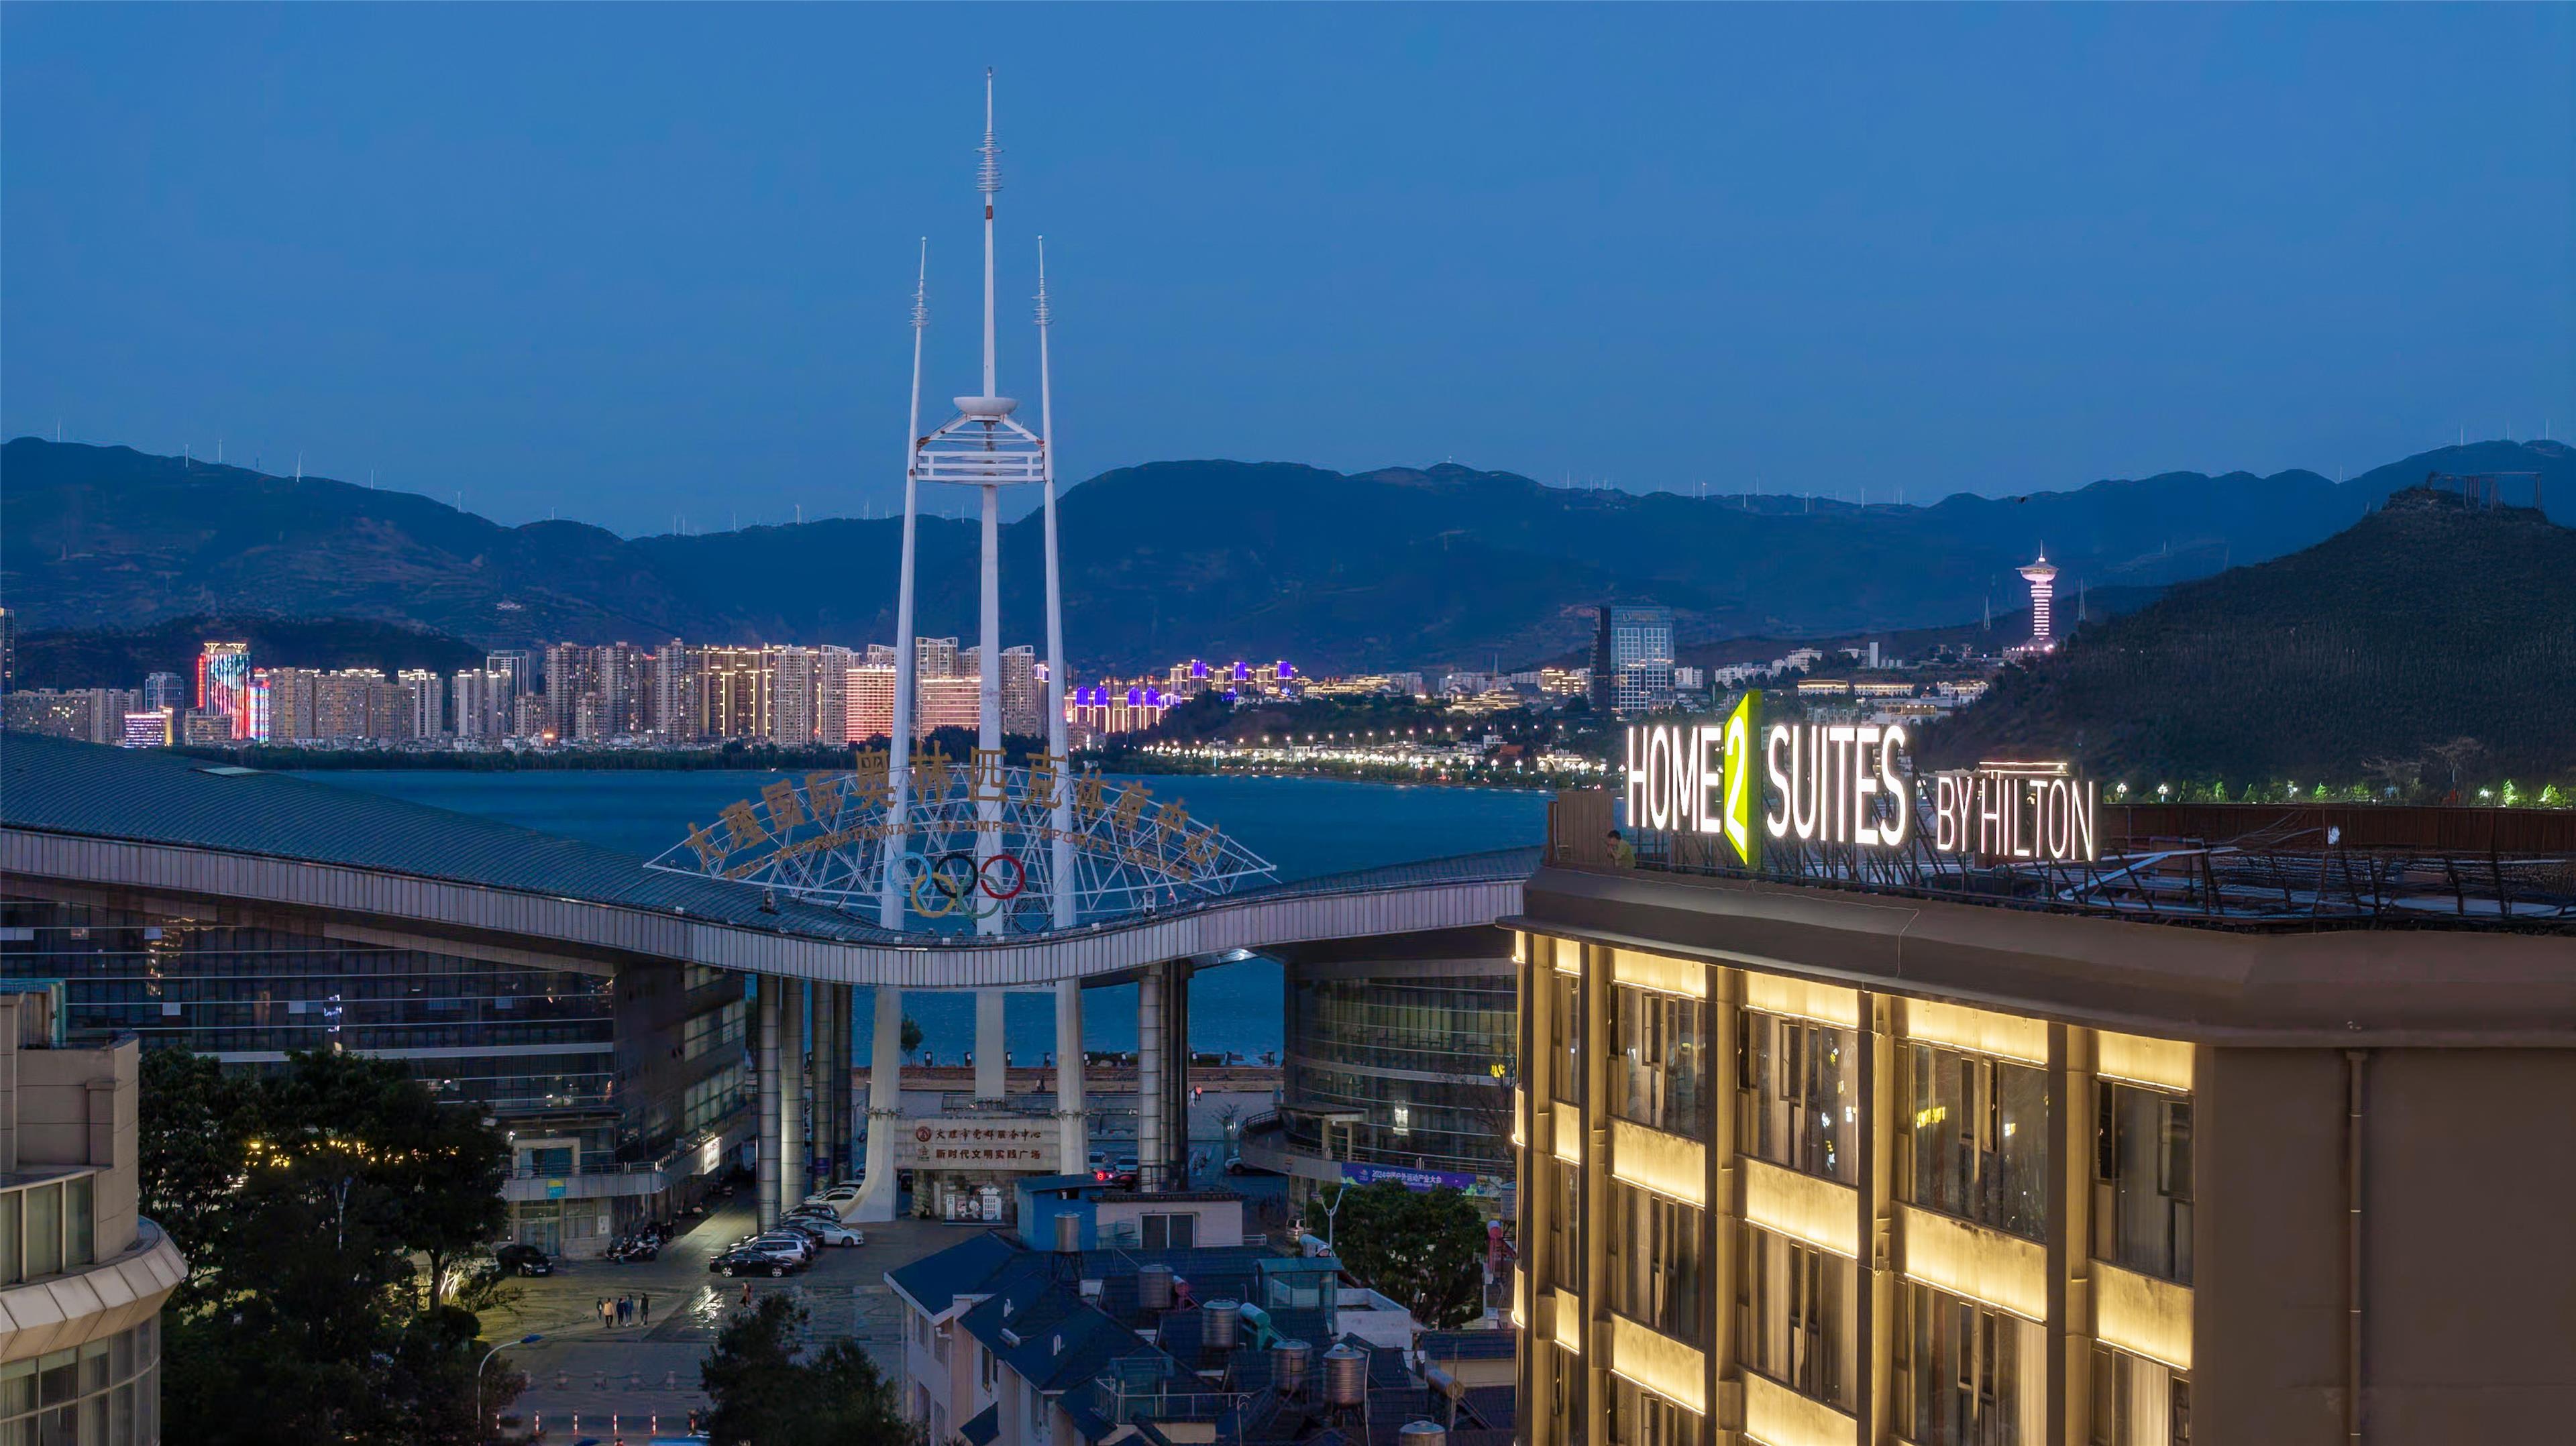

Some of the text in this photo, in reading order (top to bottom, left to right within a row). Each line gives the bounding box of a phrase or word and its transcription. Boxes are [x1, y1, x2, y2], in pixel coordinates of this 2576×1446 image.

[1767, 725, 1907, 846] SUITES
[1938, 777, 1972, 852] BY
[1981, 779, 2094, 861] HILTON
[936, 1149, 1040, 1159] 新时代文明实践广场
